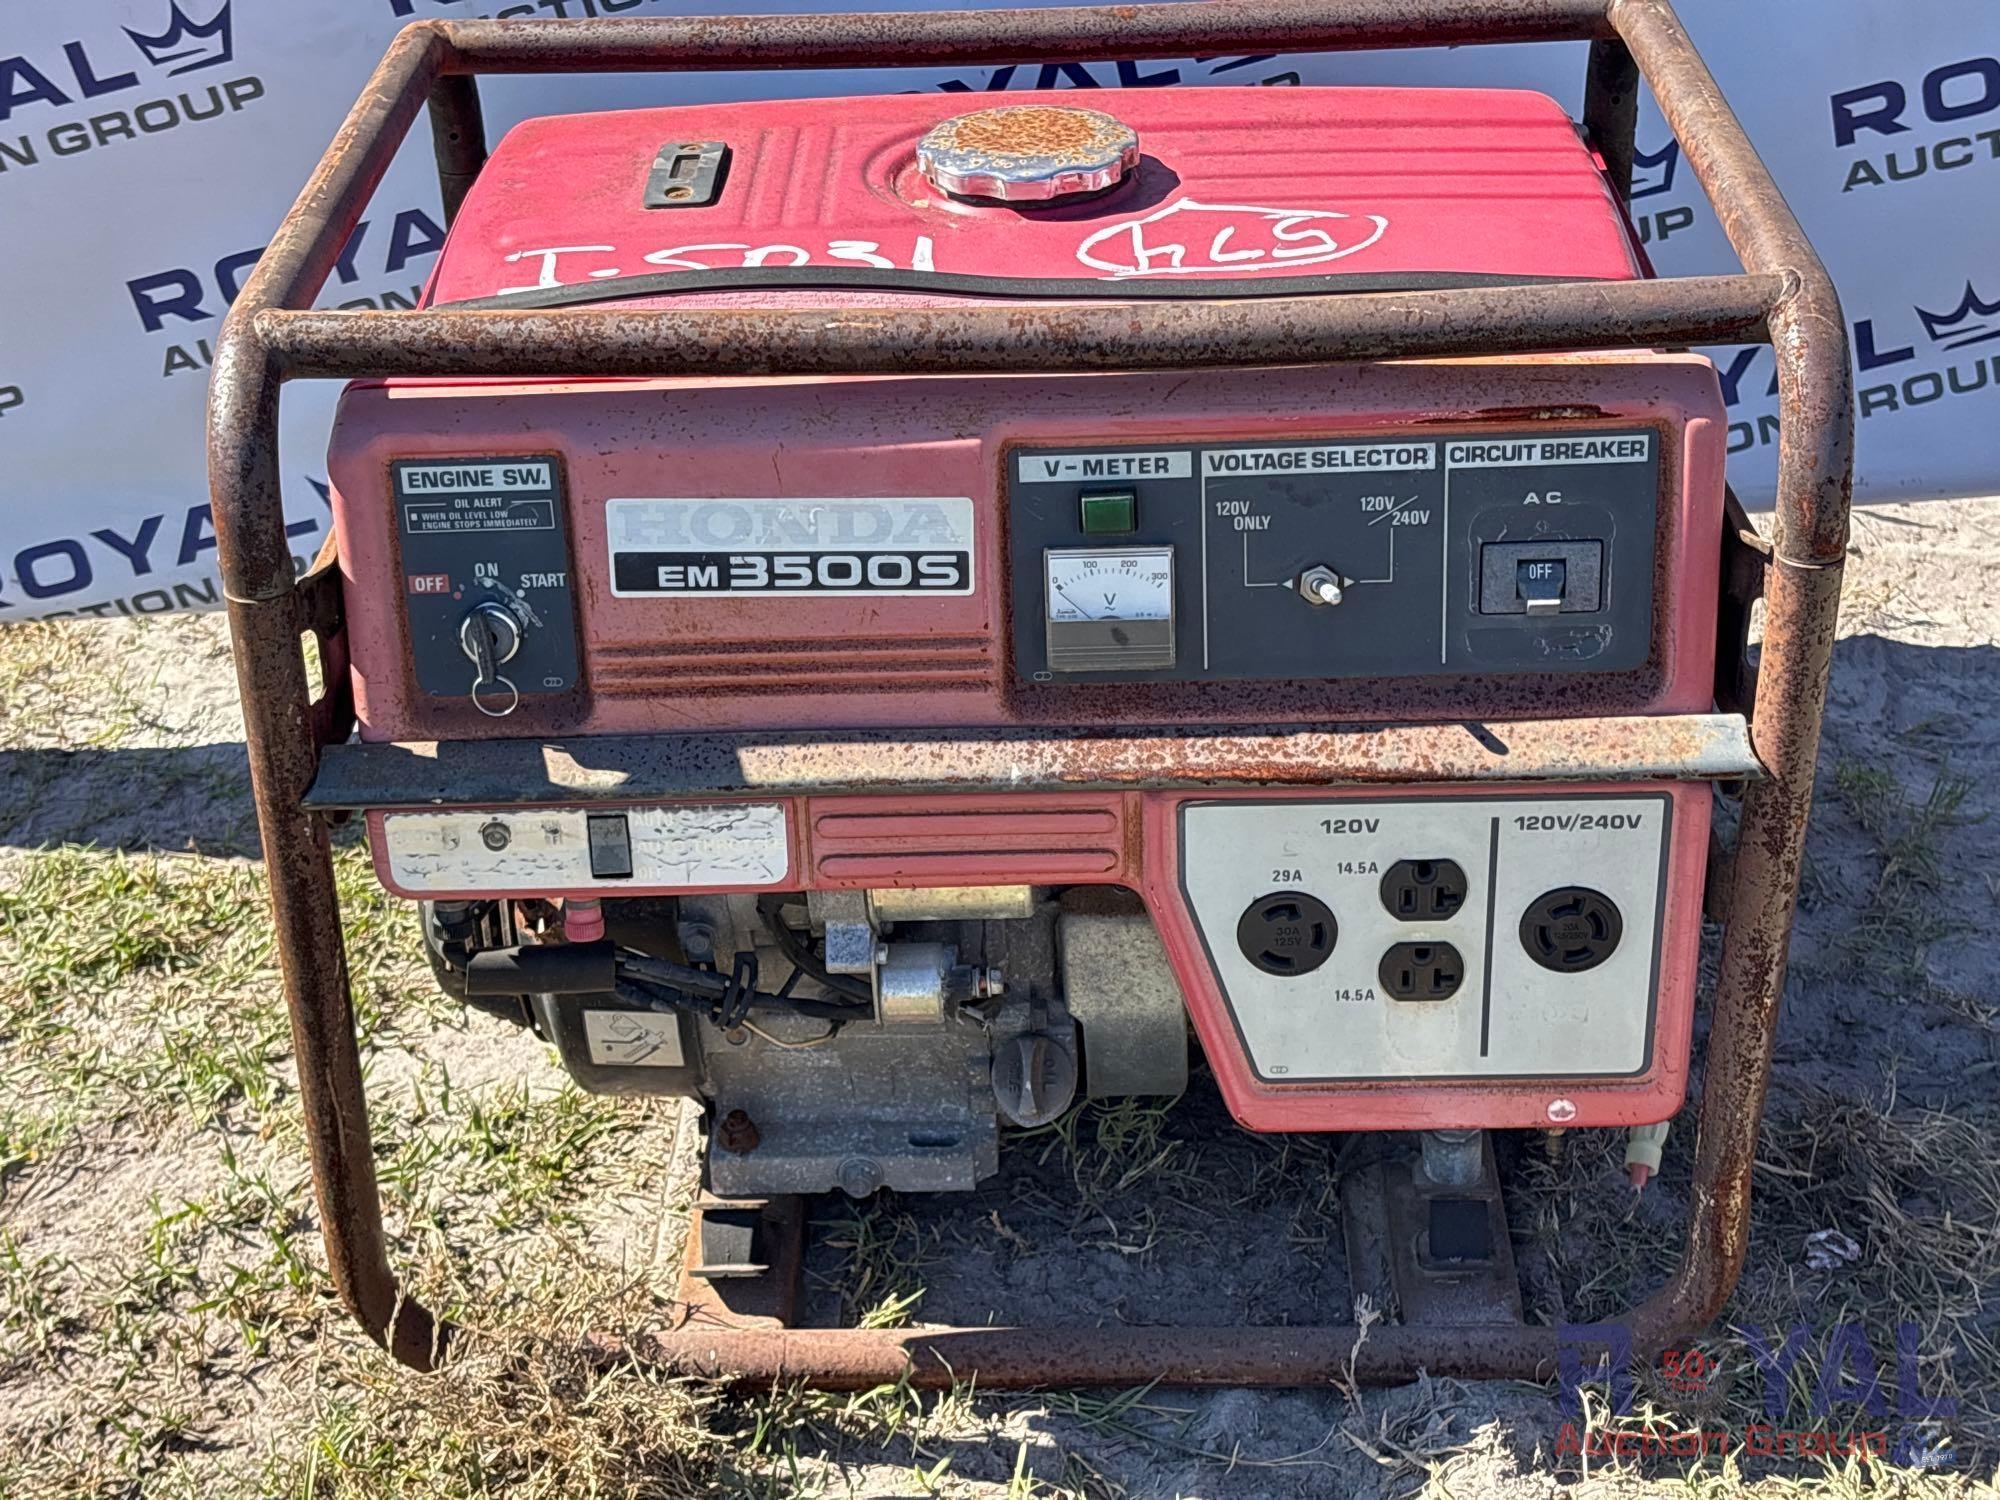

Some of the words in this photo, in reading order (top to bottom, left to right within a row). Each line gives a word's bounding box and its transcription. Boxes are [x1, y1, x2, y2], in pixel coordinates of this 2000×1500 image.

[47, 76, 265, 156] GROUP
[1209, 452, 1307, 472] VOLTAGE
[1312, 447, 1429, 468] SELECTOR
[1450, 443, 1537, 464] CIRCUIT
[1540, 440, 1646, 461] BREAKER
[407, 469, 494, 489] ENGINE
[503, 468, 547, 487] SW.
[454, 498, 470, 509] OIL
[473, 497, 503, 508] ALERT
[1215, 500, 1250, 516] 120V
[421, 512, 447, 521] WHEN
[449, 512, 463, 520] OIL
[464, 511, 488, 520] LEVEL
[490, 510, 509, 519] LOW
[1233, 515, 1271, 531] ONLY
[421, 520, 451, 530] ENGINE
[454, 519, 481, 529] STOPS
[483, 518, 538, 528] IMMEDIATELY
[616, 503, 962, 547] HONDA
[474, 562, 500, 578] ON
[1082, 560, 1098, 569] 100
[1120, 560, 1138, 568] 200
[1529, 563, 1553, 580] OFF
[520, 573, 567, 588] START
[1151, 572, 1168, 580] 300
[415, 577, 444, 591] OFF
[1103, 592, 1117, 606] V
[1319, 818, 1380, 834] 120V
[1514, 813, 1643, 832] 120V/240V
[1271, 869, 1303, 882] 29A
[1337, 861, 1379, 875] 14.5A
[1334, 988, 1376, 1002] 14.5A
